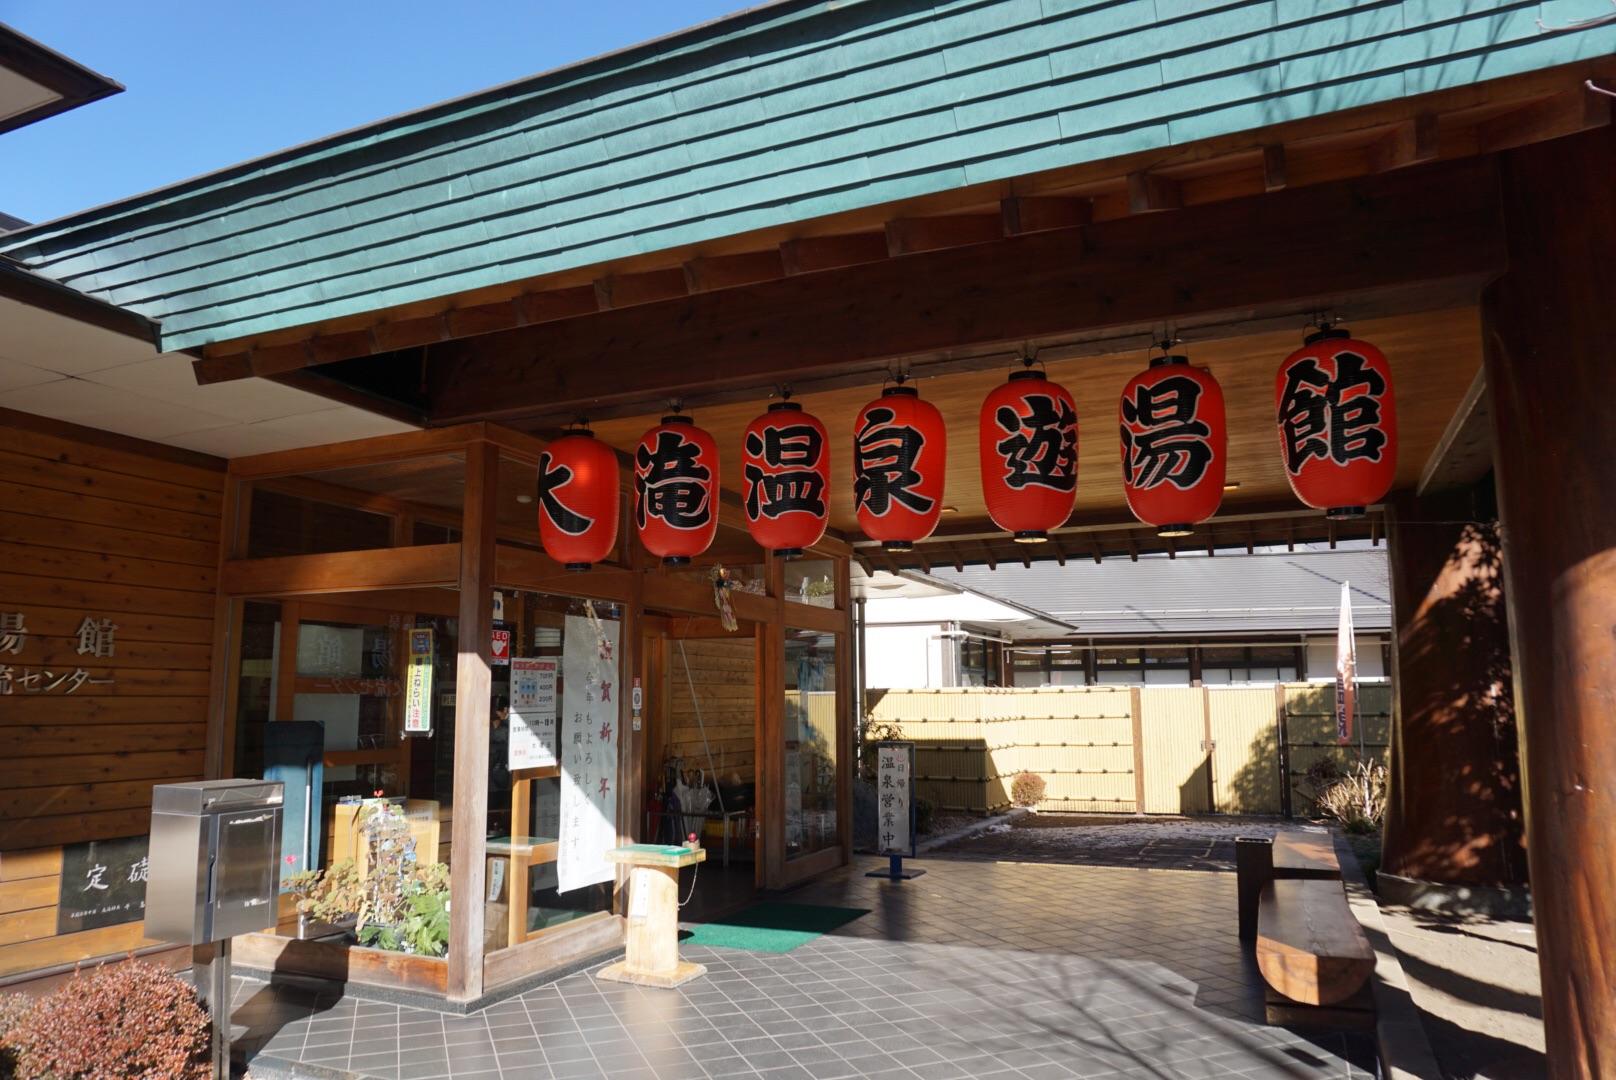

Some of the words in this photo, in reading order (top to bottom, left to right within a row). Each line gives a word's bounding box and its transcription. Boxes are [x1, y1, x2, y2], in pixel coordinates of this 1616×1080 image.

[881, 756, 896, 847] 温泉営業中
